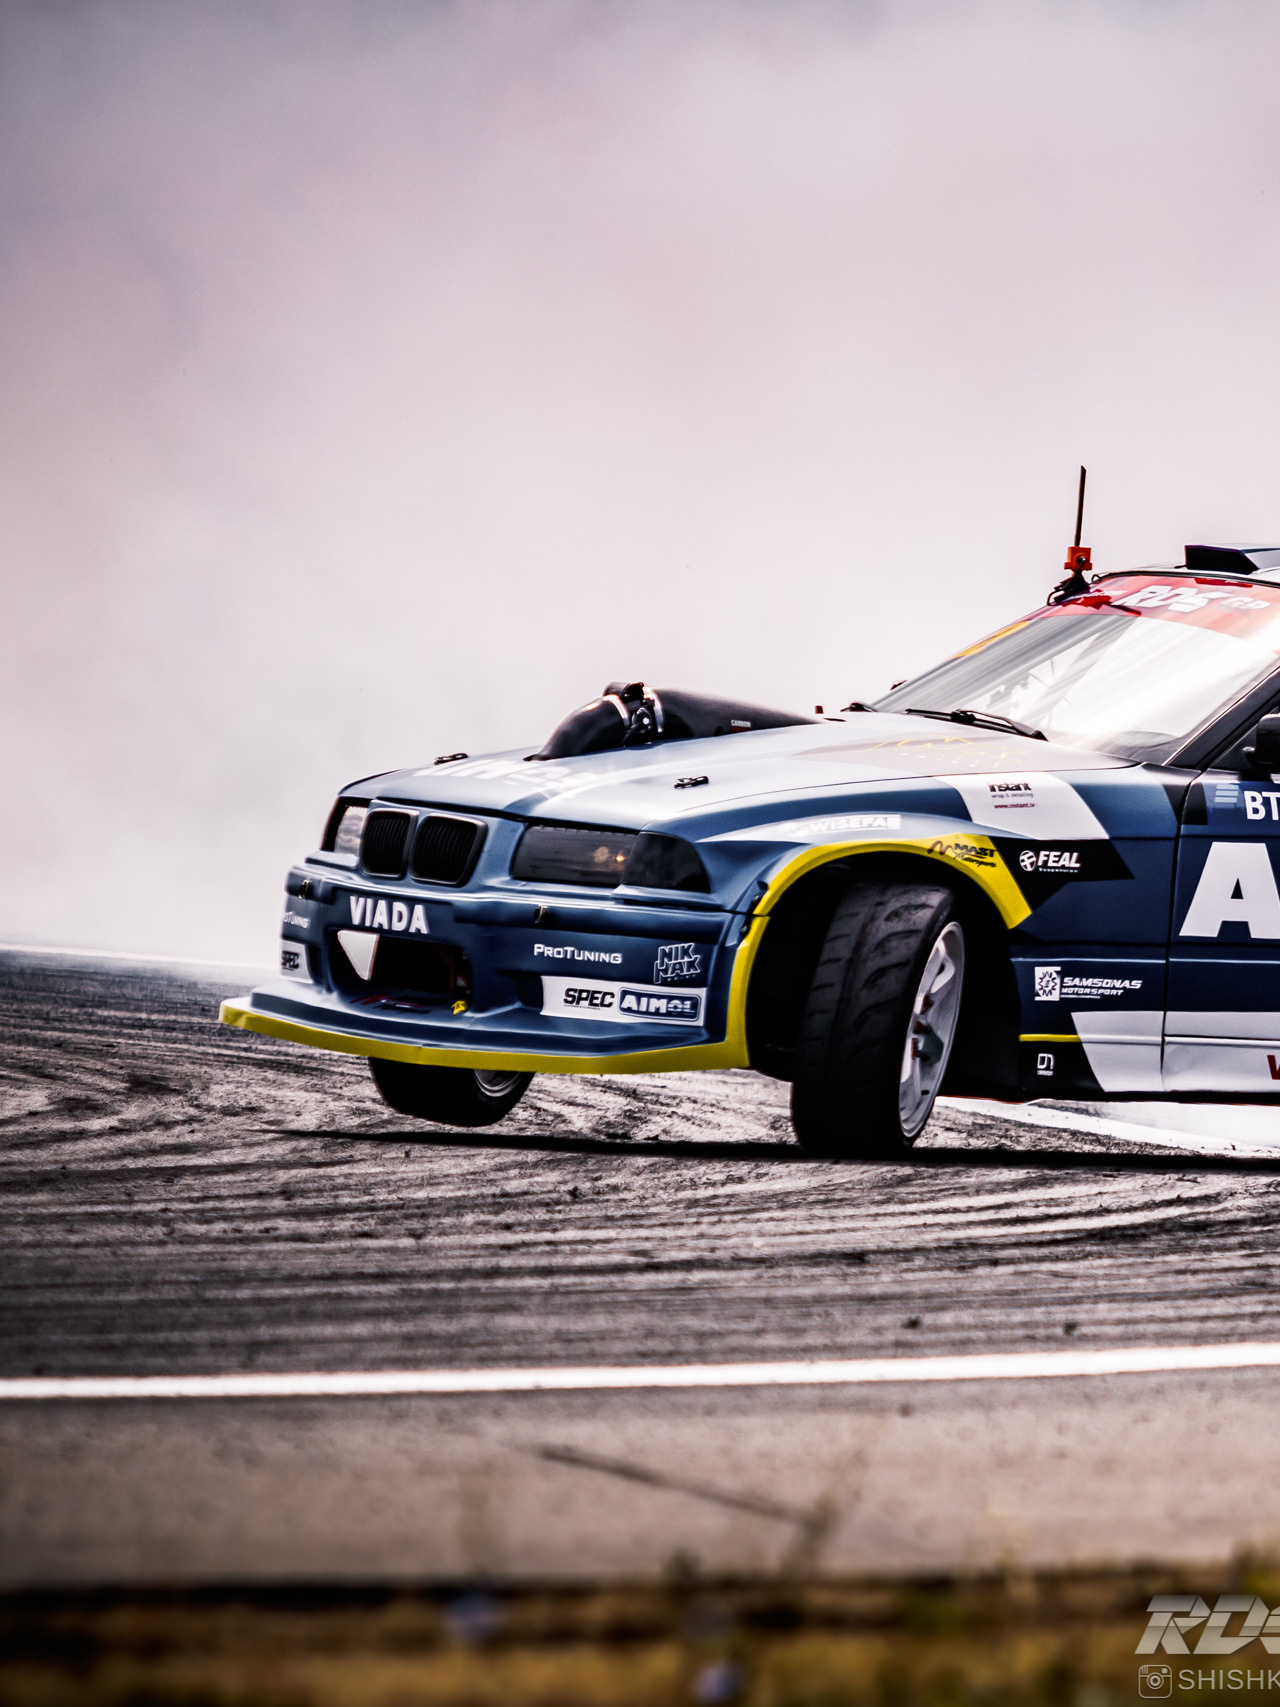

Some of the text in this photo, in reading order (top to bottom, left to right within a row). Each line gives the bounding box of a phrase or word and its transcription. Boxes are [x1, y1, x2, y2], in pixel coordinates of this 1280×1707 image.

[1111, 585, 1236, 612] RDS
[954, 842, 996, 857] MAST
[1037, 850, 1081, 867] FEAL
[350, 896, 430, 934] VIADA
[658, 943, 694, 969] NIK
[654, 955, 701, 984] NAK
[1061, 987, 1124, 996] MOTORSPORT
[1062, 977, 1142, 989] SAMSONAS
[563, 987, 615, 1008] SPEC
[621, 994, 696, 1015] AIMOL
